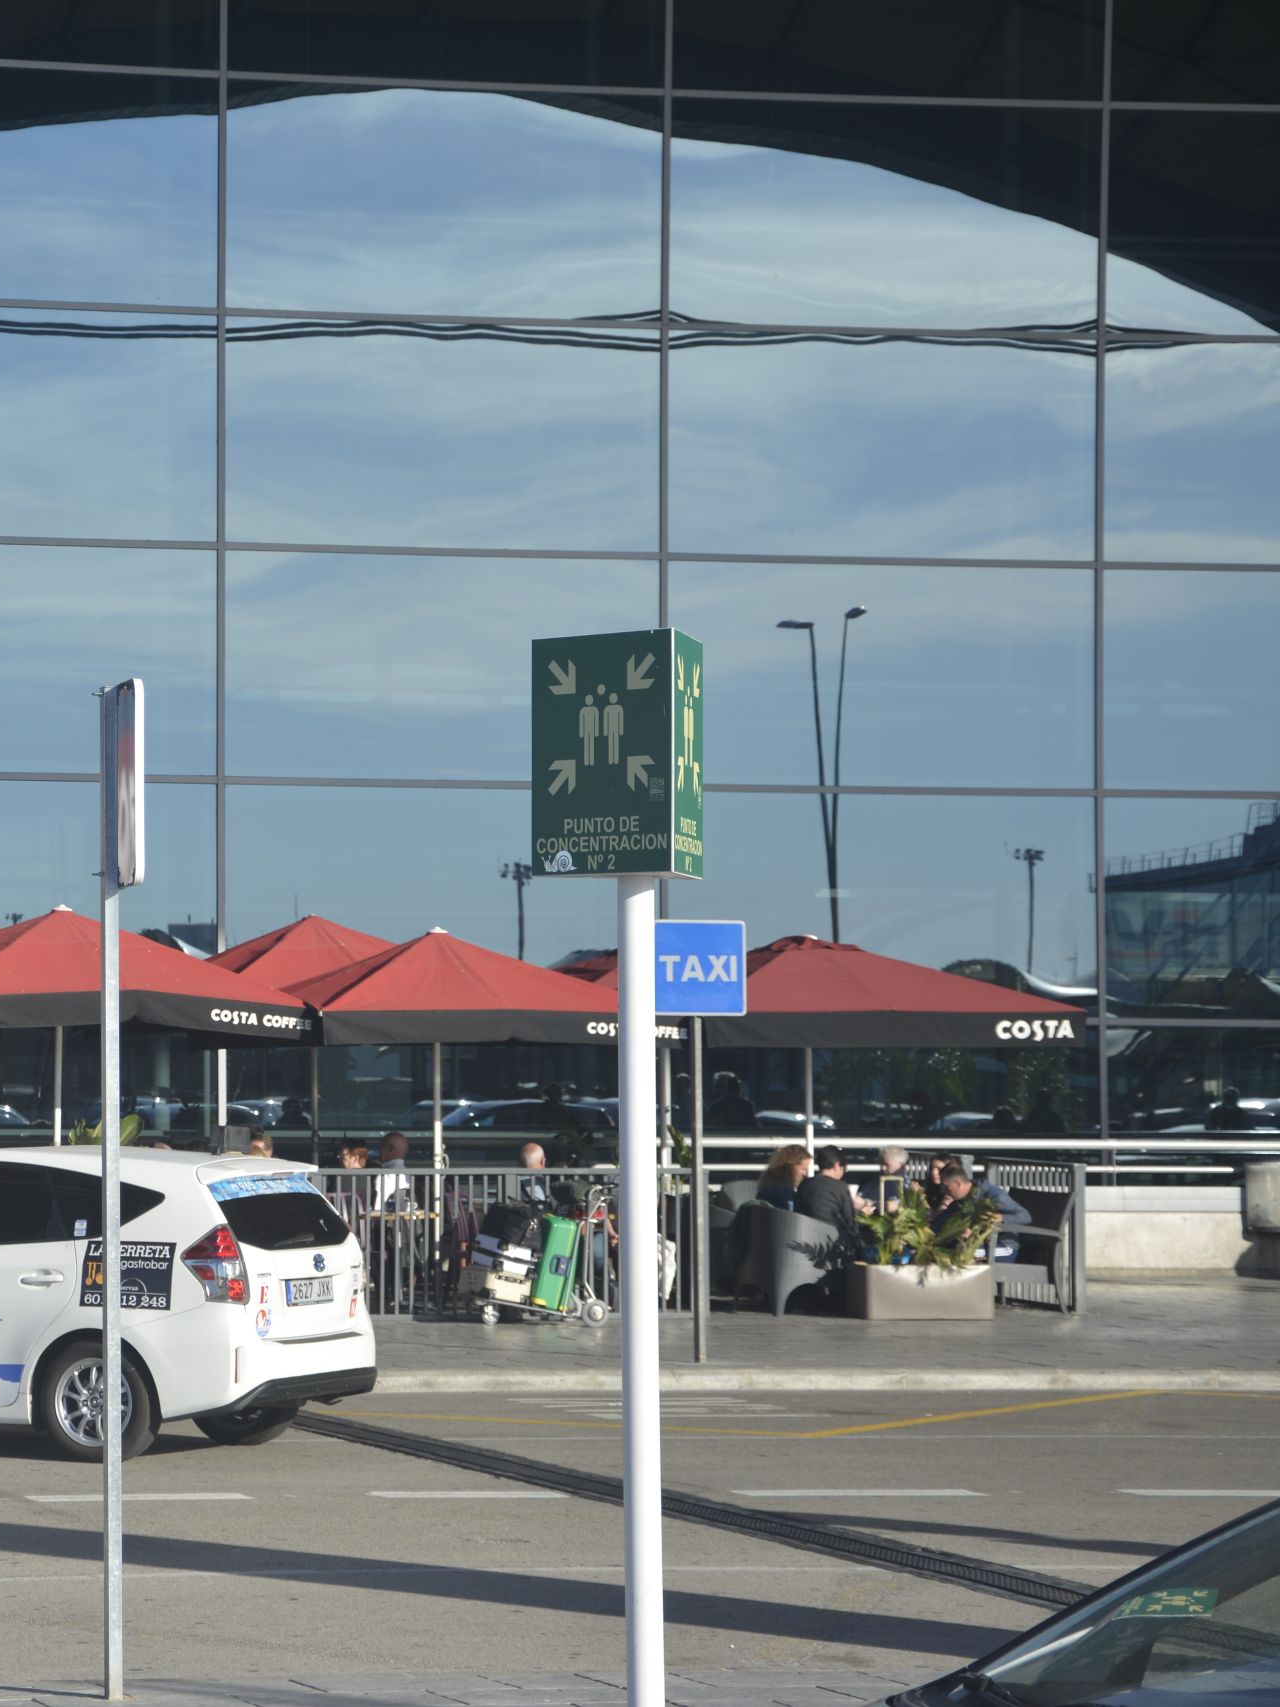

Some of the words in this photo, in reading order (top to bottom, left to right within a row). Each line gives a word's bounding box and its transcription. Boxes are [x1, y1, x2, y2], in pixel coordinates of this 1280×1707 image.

[563, 817, 615, 835] PUNTO
[619, 815, 640, 832] DE
[536, 833, 668, 854] CONCENTRACION
[607, 854, 616, 870] 2
[658, 955, 738, 982] TAXI
[210, 1008, 258, 1025] COSTA
[262, 1014, 312, 1030] COFFEE
[586, 1021, 619, 1037] COS
[994, 1018, 1075, 1043] COSTA
[120, 1245, 171, 1258] ERRETA
[120, 1259, 169, 1270] gastrobar
[292, 1281, 314, 1300] 2627
[317, 1279, 332, 1298] JXK
[84, 1293, 103, 1305] 60
[121, 1295, 137, 1306] 12
[141, 1296, 167, 1308] 248
